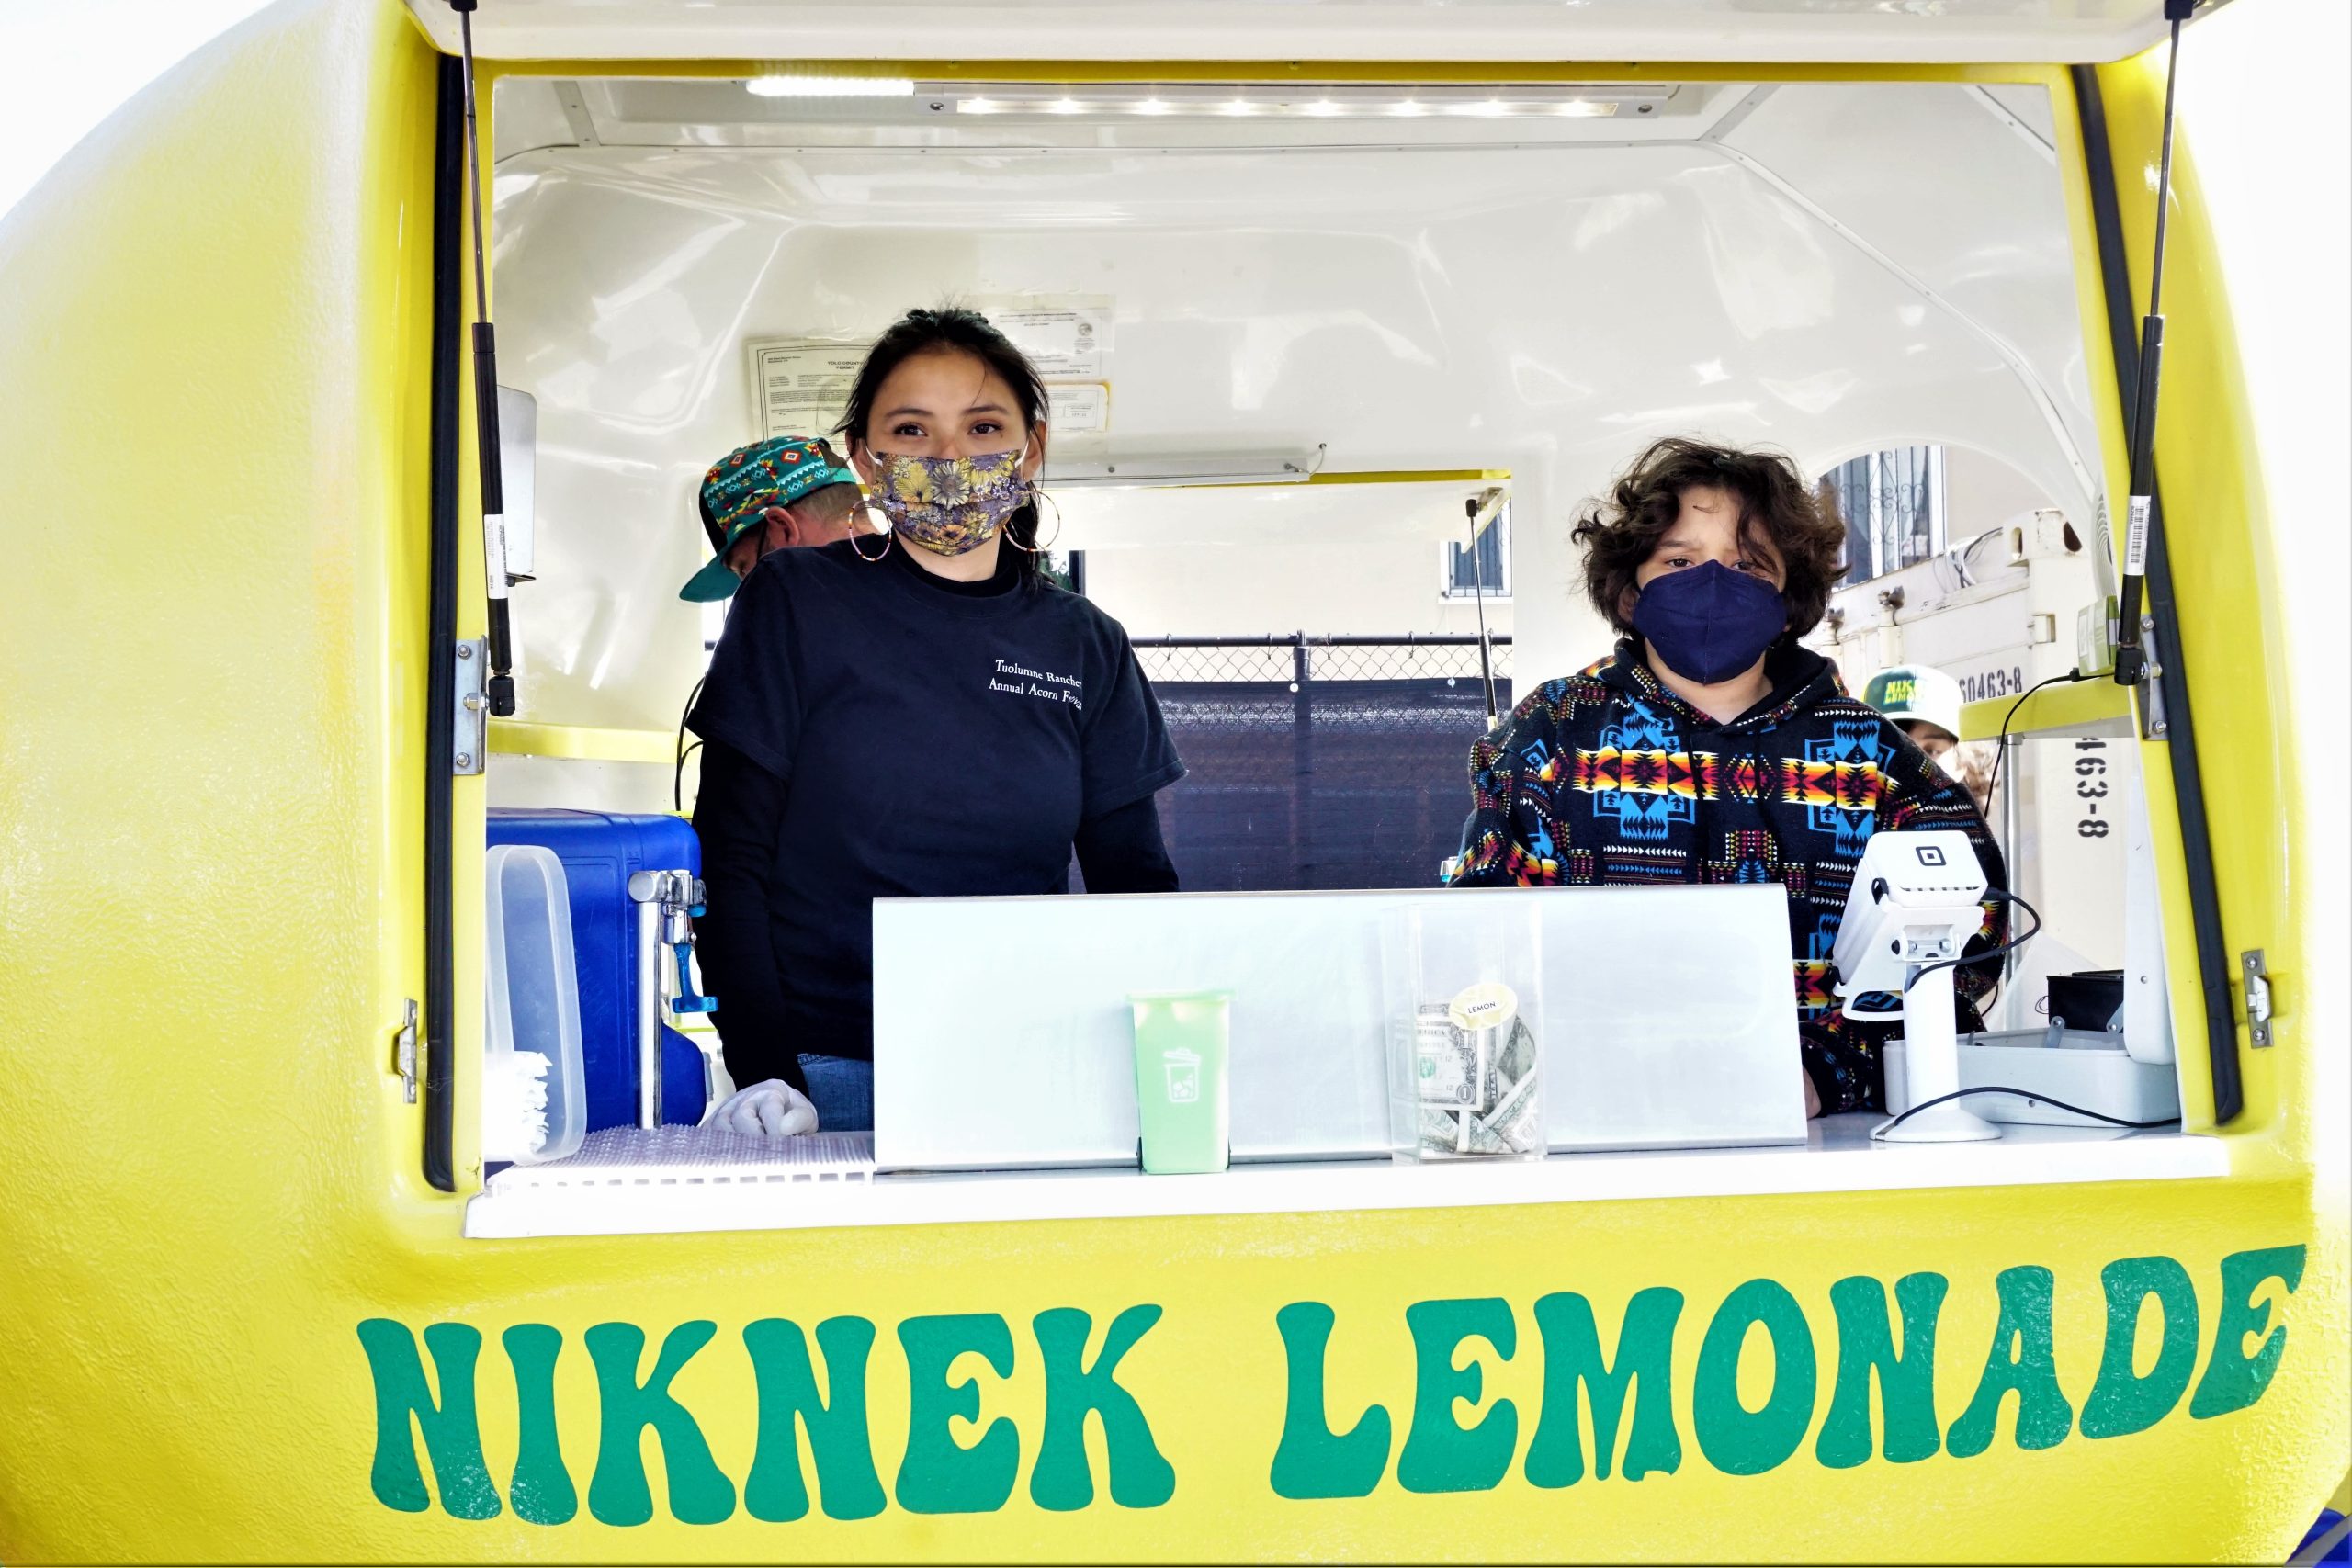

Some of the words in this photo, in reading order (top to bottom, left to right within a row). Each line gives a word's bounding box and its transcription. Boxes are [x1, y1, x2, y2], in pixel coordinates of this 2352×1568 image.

[995, 659, 1044, 680] Tuolumne
[989, 677, 1024, 694] Annual
[1028, 683, 1058, 700] Acorn
[1467, 1001, 1496, 1014] LEMON
[356, 1303, 1176, 1527] NIKNEK
[1271, 1245, 2307, 1500] LEMONADE
